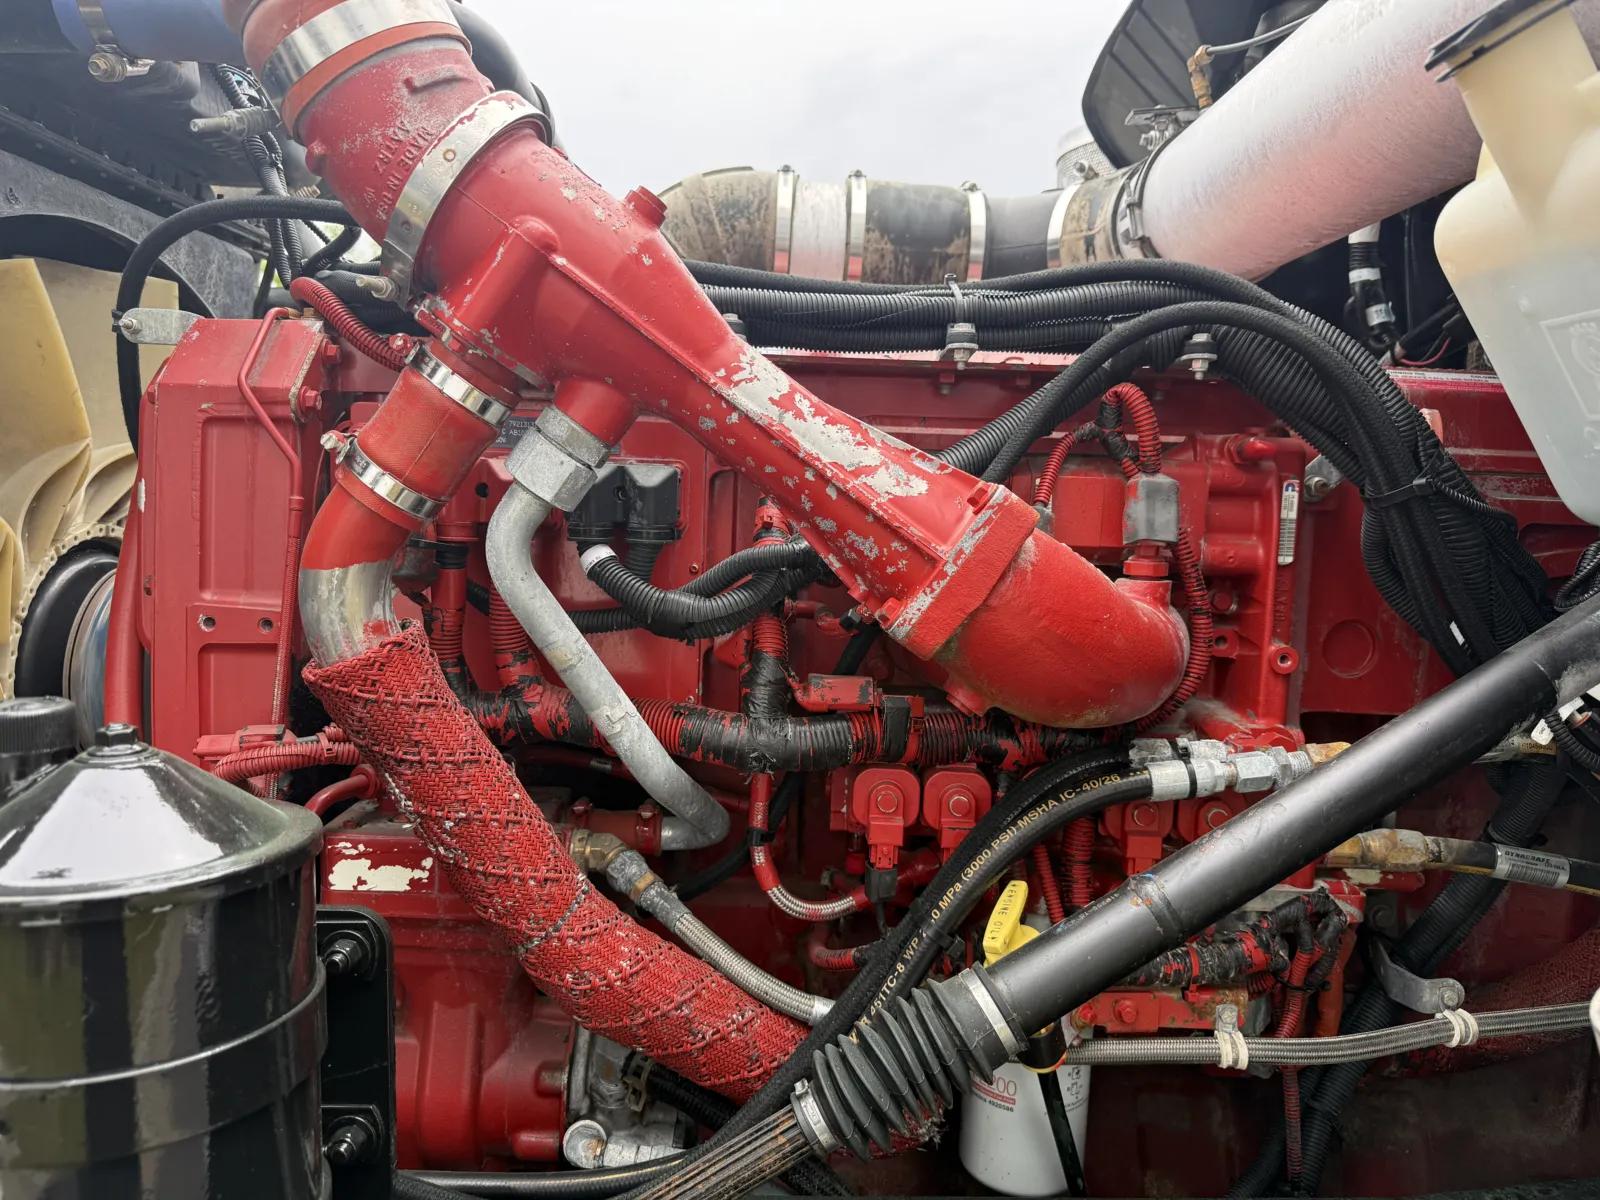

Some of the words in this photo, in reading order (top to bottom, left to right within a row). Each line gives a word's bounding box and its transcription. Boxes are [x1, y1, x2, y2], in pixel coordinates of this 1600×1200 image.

[396, 126, 434, 171] MADE
[386, 172, 403, 191] IN
[376, 191, 393, 221] USA
[903, 937, 918, 960] WP
[938, 882, 963, 910] MPa
[961, 848, 992, 881] (3000
[991, 826, 1017, 850] PSI)
[1017, 799, 1059, 829] MSHA
[1059, 773, 1121, 802] IC-40/26
[998, 889, 1017, 916] ENGINE
[990, 921, 1003, 935] OIL
